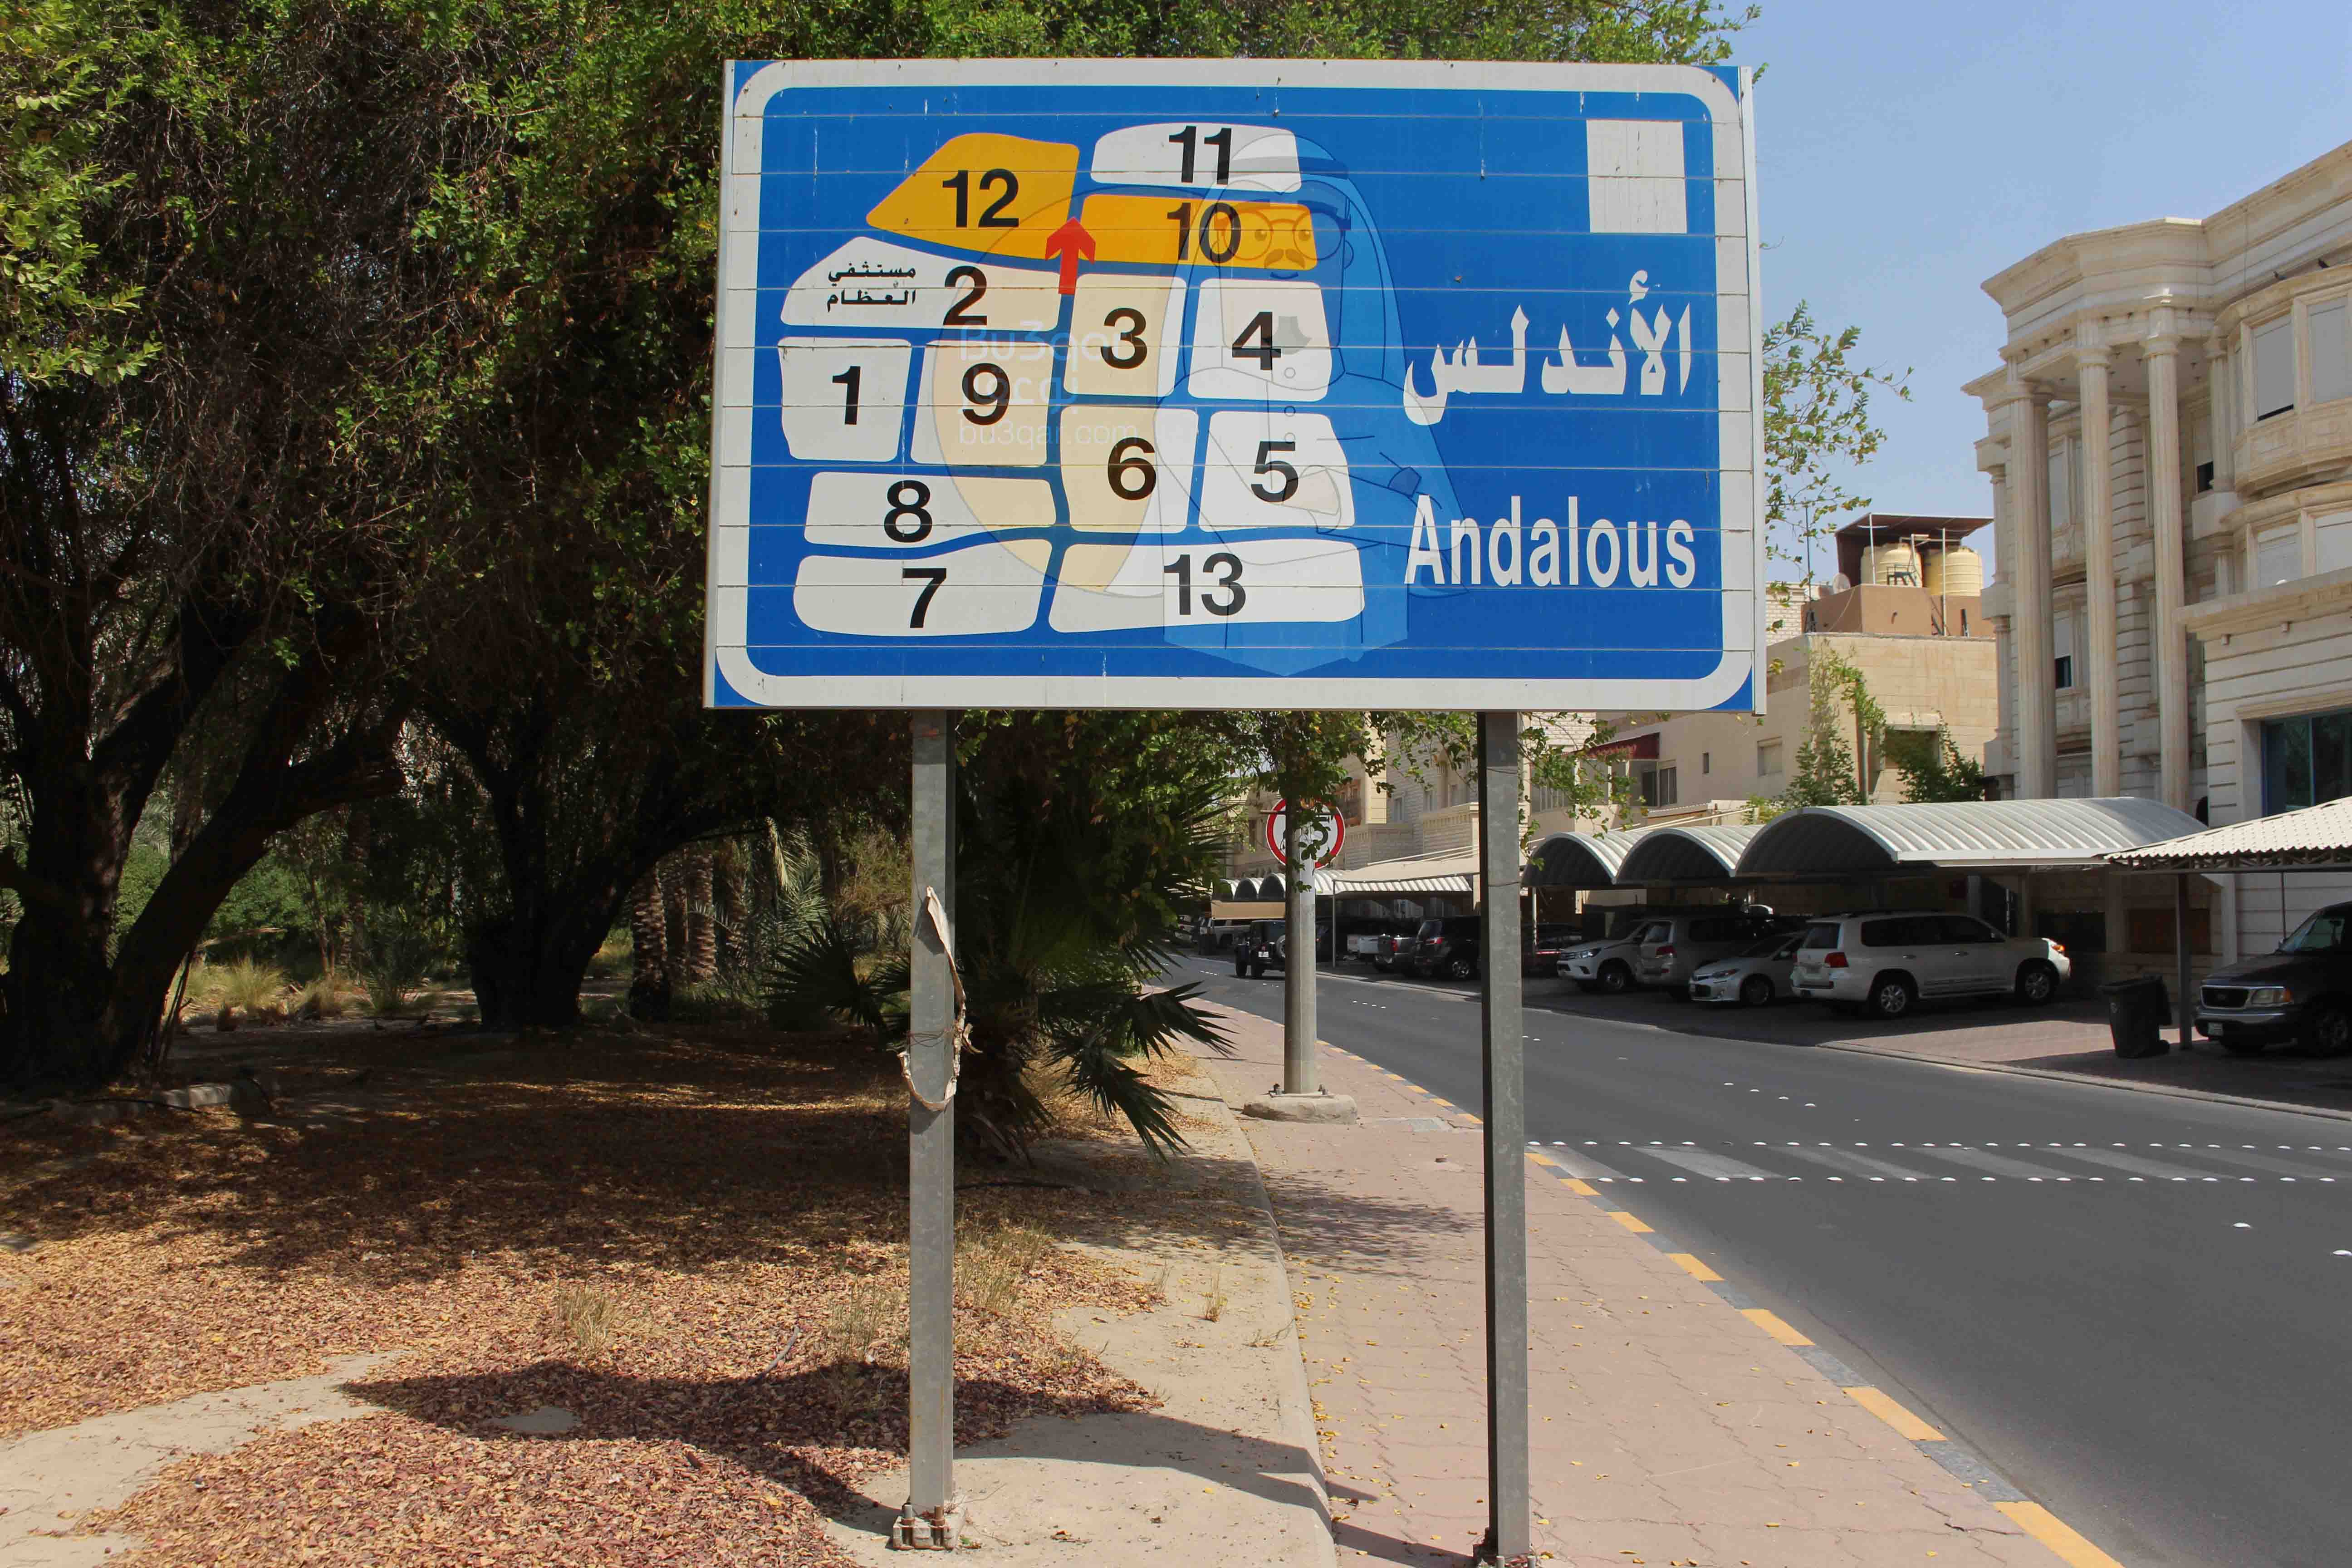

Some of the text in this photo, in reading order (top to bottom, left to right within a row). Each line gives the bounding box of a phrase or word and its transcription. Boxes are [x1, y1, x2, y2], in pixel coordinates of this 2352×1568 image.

[1169, 125, 1232, 185] 11
[942, 168, 1019, 228] 12
[1167, 202, 1241, 264] 10
[827, 289, 916, 313] العظام
[942, 265, 988, 326] 2
[1100, 308, 1148, 369] 3
[1231, 311, 1282, 371] 4
[1403, 270, 1692, 426] الأندلس
[832, 366, 861, 425] 1
[962, 363, 1010, 425] 9
[1107, 437, 1157, 501] 6
[1251, 441, 1299, 503] 5
[883, 480, 933, 543] 8
[1405, 495, 1696, 589] Andalous
[902, 568, 947, 629] 7
[1163, 553, 1246, 616] 13
